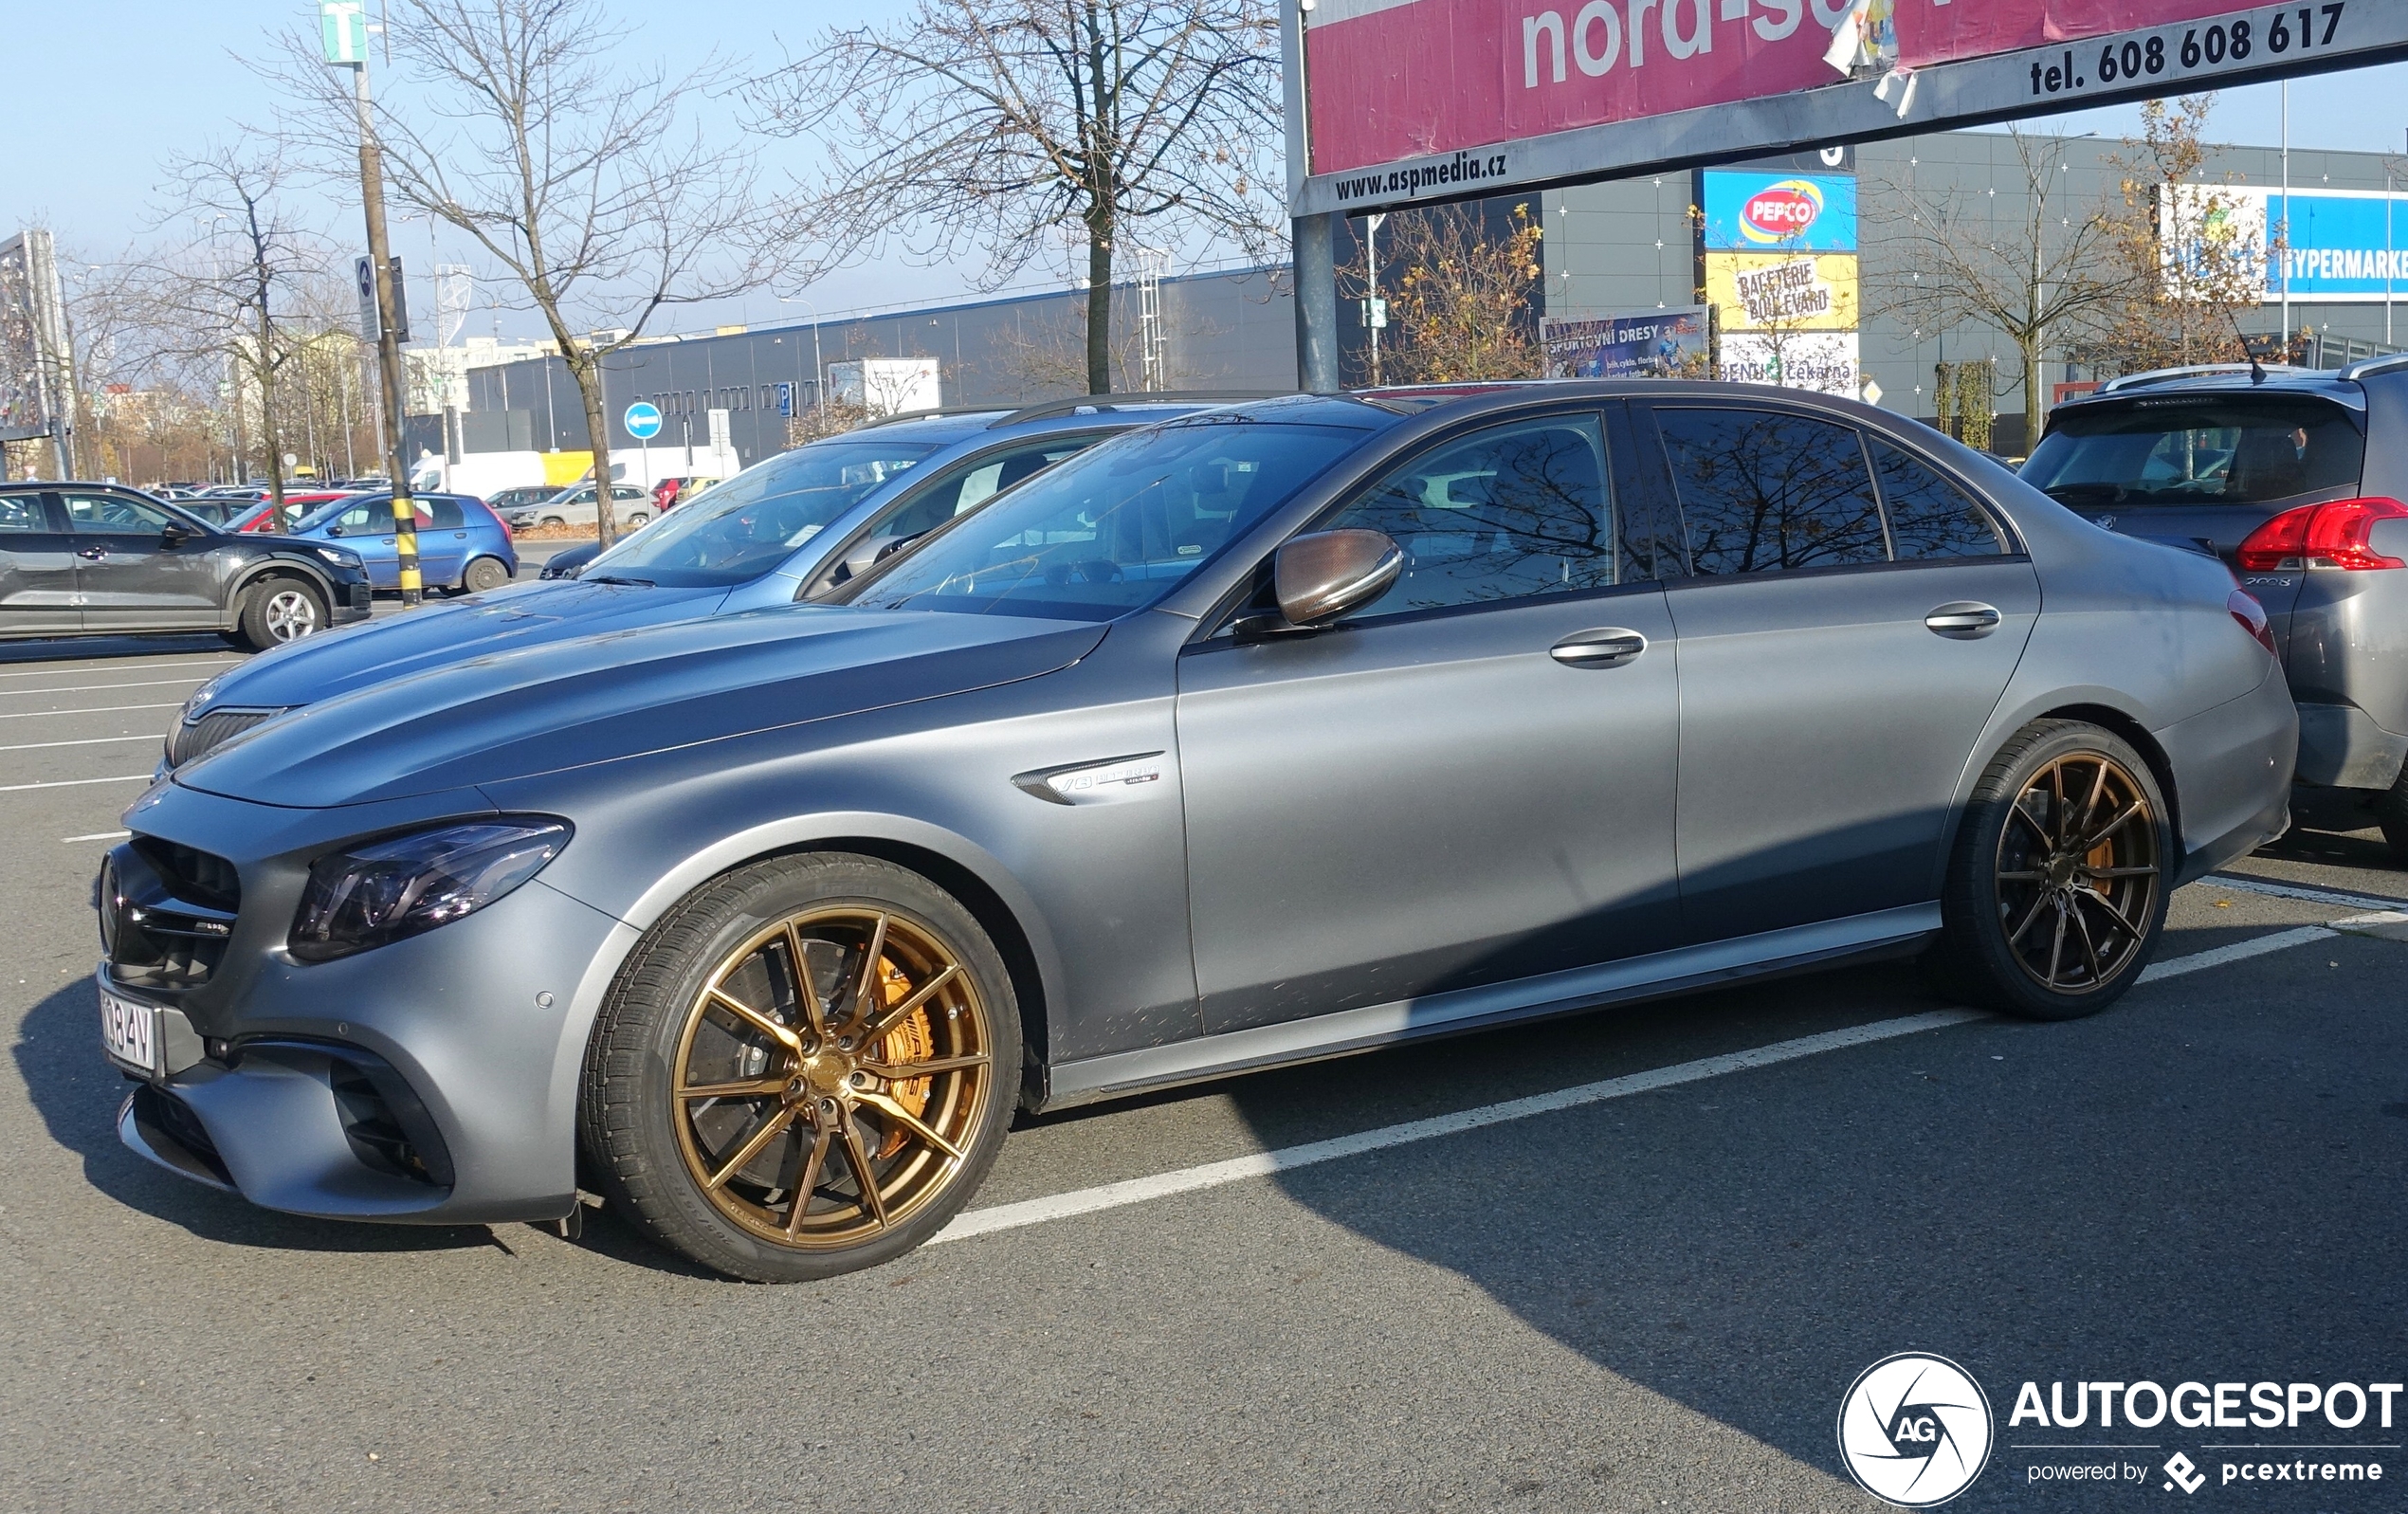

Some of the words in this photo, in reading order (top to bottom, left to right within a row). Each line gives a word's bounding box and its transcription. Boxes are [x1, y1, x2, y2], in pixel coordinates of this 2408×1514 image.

[2031, 51, 2084, 95] tel.
[2098, 36, 2164, 82] 608
[2180, 20, 2251, 68] 608
[2268, 2, 2344, 53] 617
[1336, 151, 1506, 200] www.aspmedia.cz
[1752, 201, 1812, 223] PEPCO
[1619, 324, 1659, 344] DRESY
[781, 388, 788, 408] P
